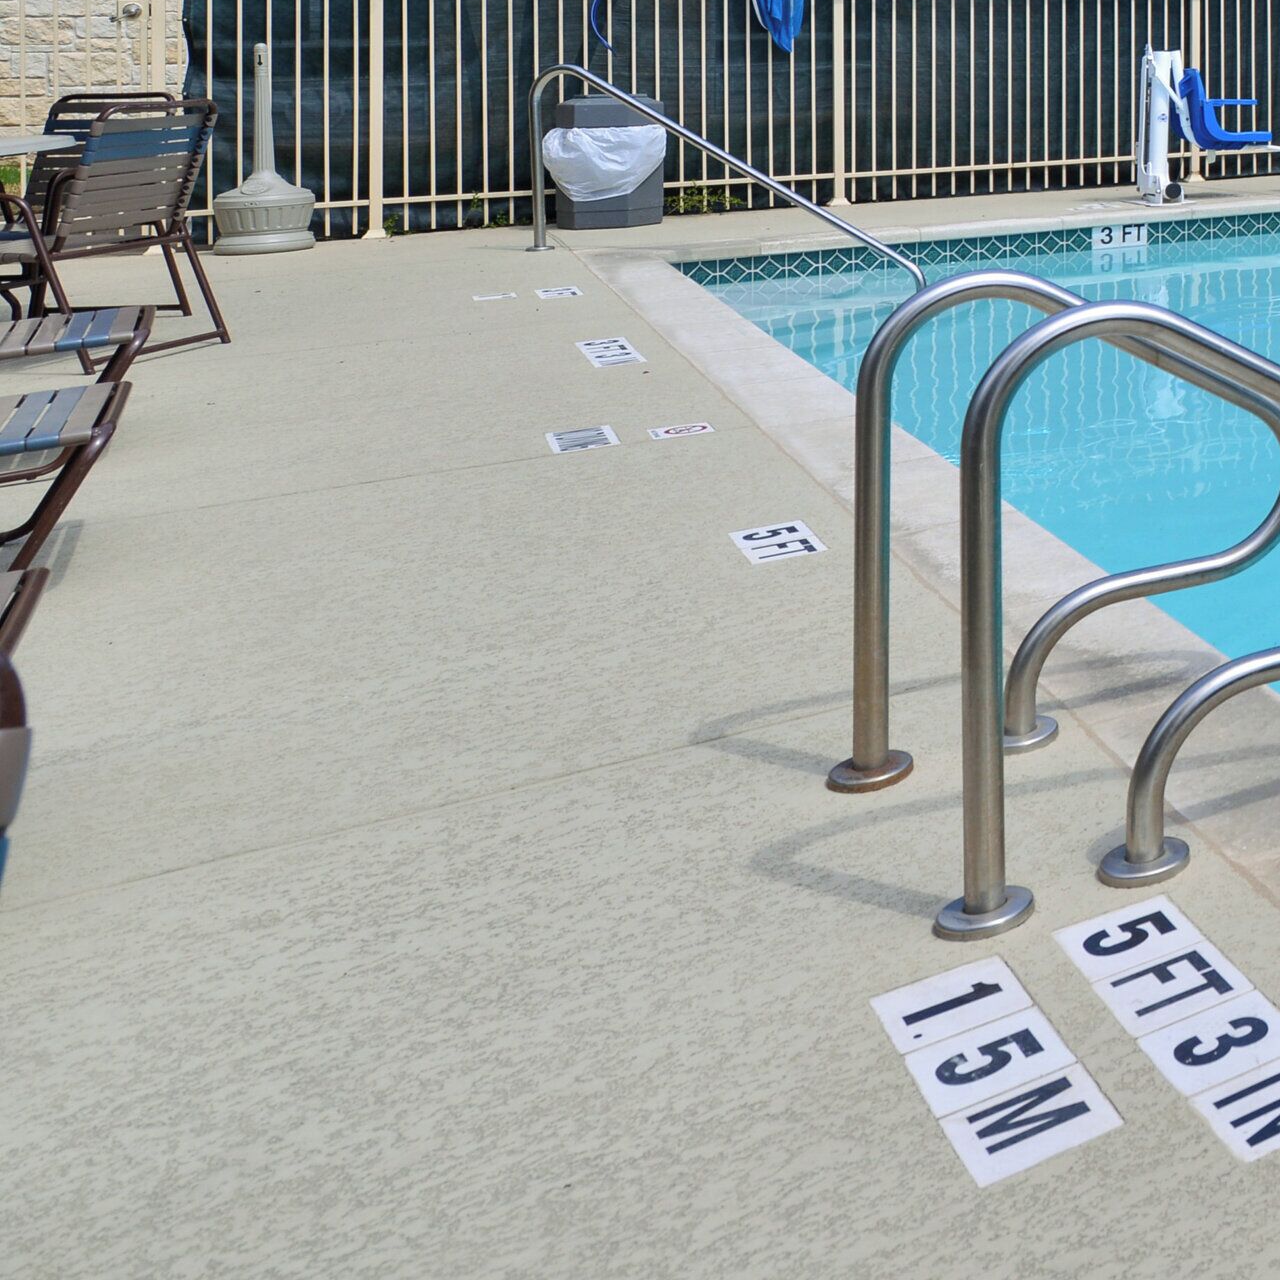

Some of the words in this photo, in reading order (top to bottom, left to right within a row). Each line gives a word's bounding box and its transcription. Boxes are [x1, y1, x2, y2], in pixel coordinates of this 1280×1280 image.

[1100, 226, 1113, 245] 3
[1122, 223, 1145, 243] FT
[742, 525, 799, 541] 5
[751, 538, 818, 560] FT
[1082, 909, 1178, 957] 5
[1110, 949, 1235, 1018] FT
[1173, 1016, 1270, 1067] 3
